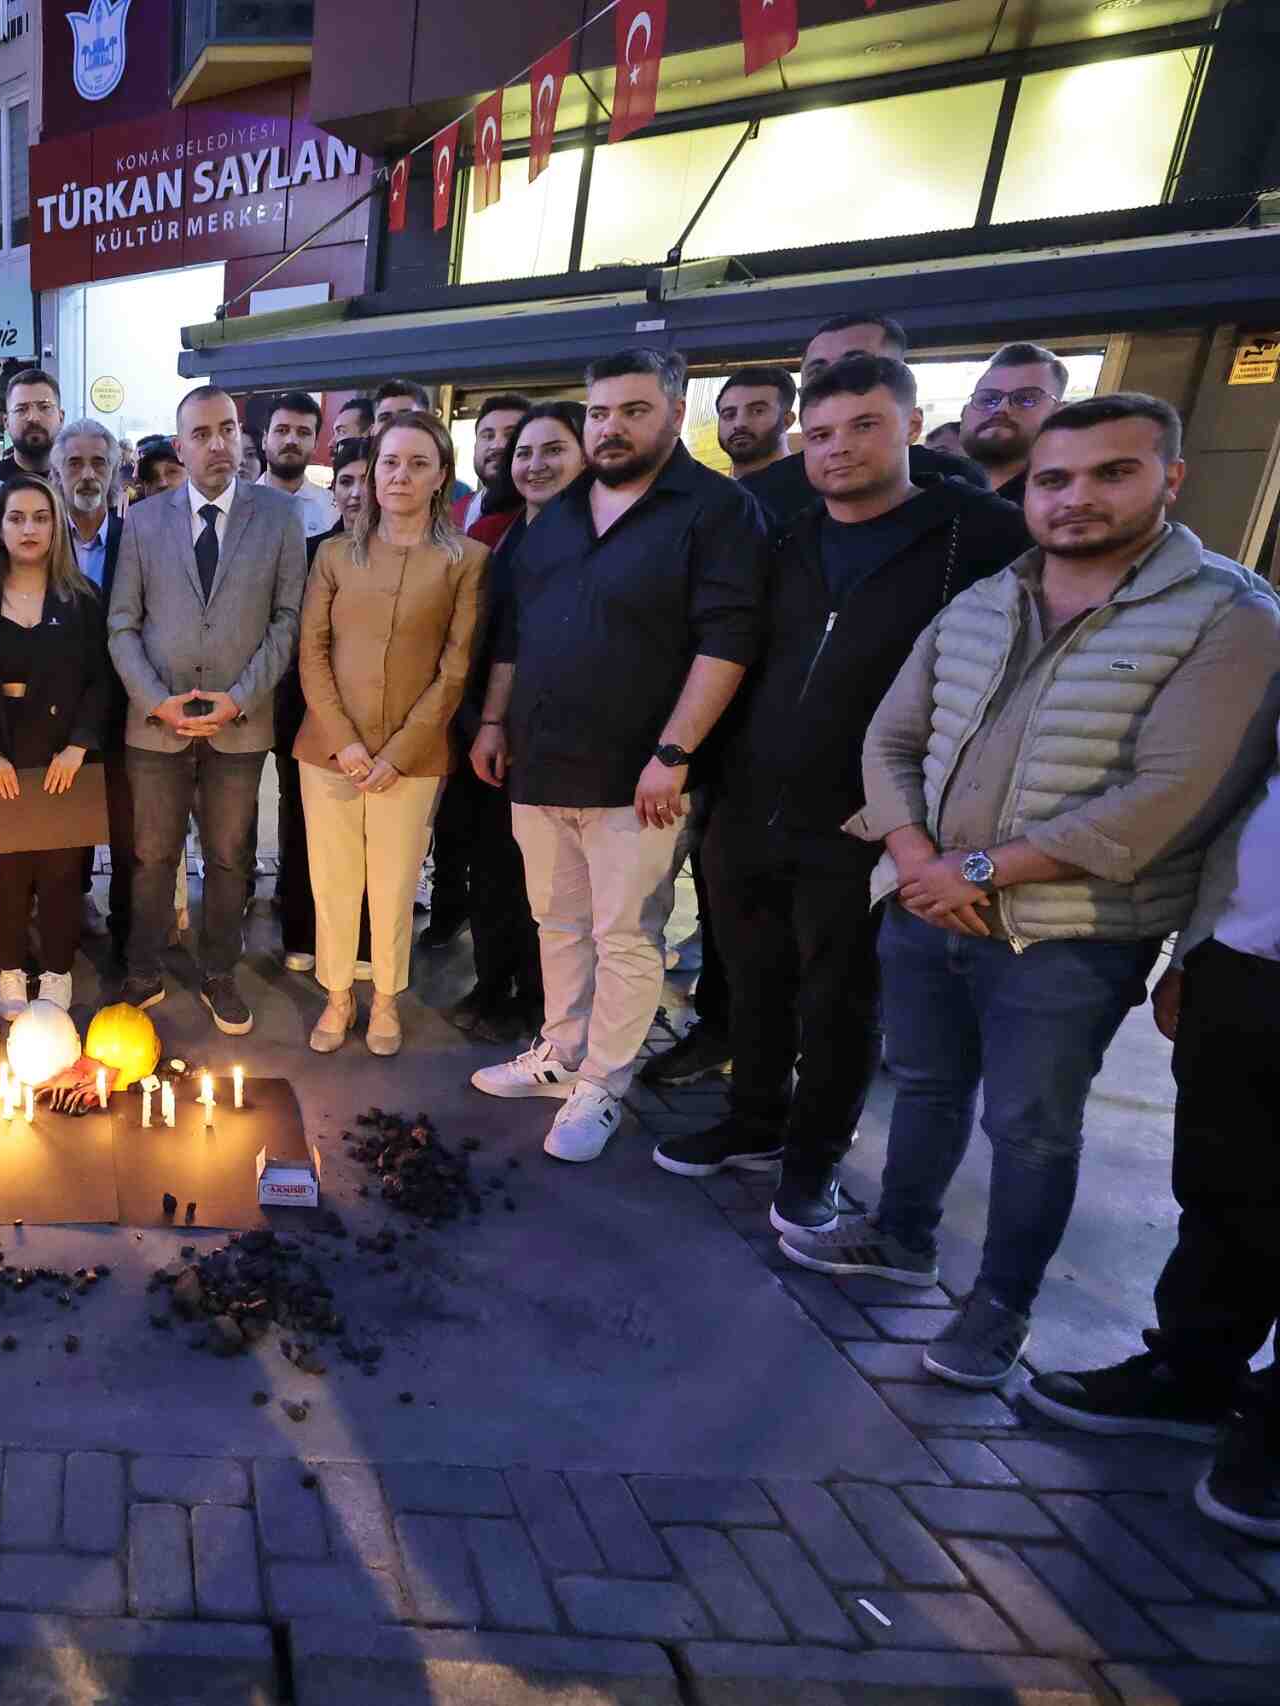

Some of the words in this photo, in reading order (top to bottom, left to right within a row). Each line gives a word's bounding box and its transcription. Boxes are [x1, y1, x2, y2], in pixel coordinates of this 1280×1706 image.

[116, 145, 170, 173] KONAK
[176, 119, 277, 159] BELEDİYESİ
[37, 168, 184, 234] TÜRKAN
[192, 135, 361, 206] SAYLAN
[95, 220, 180, 253] KÜLTÜR
[187, 195, 294, 237] MERKEZİ
